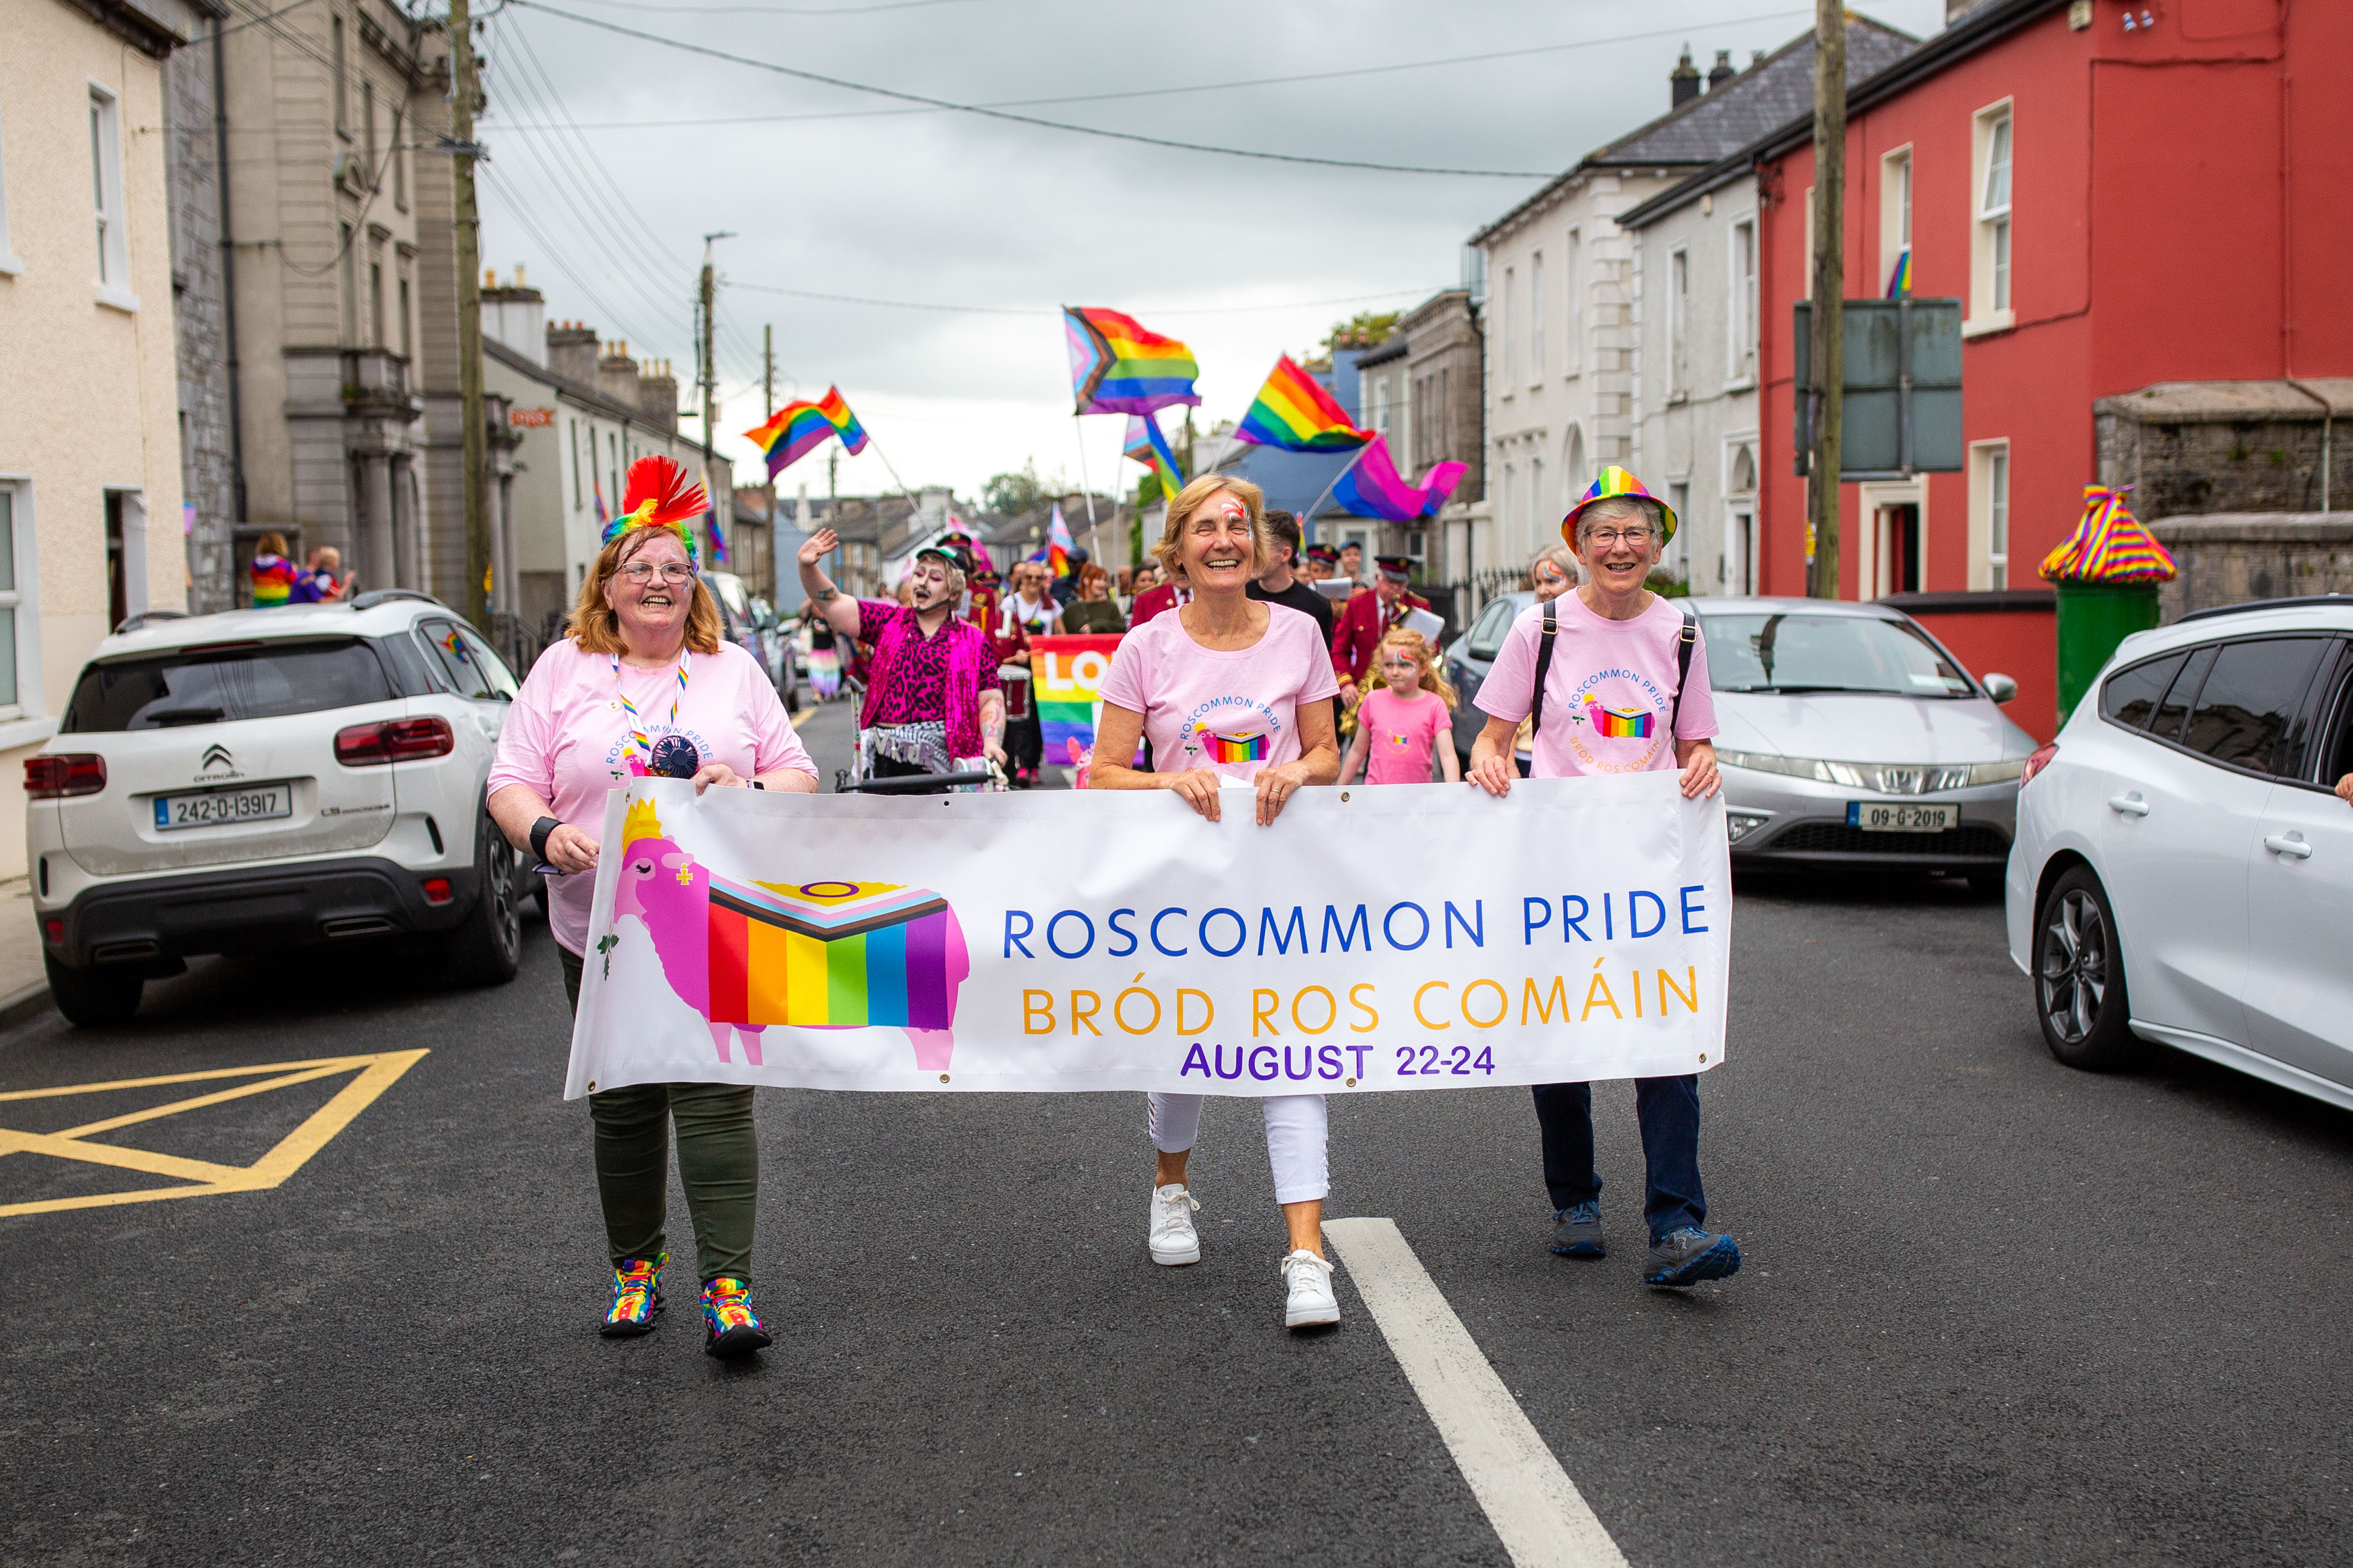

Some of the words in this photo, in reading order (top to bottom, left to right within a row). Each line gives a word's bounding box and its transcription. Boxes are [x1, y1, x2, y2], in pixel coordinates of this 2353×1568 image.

[1044, 650, 1116, 690] LO
[1568, 669, 1639, 709] ROSCOMMON
[1642, 681, 1666, 713] PRIDE
[1180, 696, 1253, 740] ROSCOMMON
[1257, 703, 1281, 732] PRIDE
[686, 730, 713, 759] PRIDE
[1570, 737, 1593, 764] BRÓD
[1597, 762, 1619, 773] ROS
[1624, 740, 1660, 772] COMÁIN
[177, 793, 277, 822] 242-D-13917
[1872, 809, 1946, 827] 09-G-2019
[1004, 899, 1485, 959] ROSCOMMON
[1523, 885, 1709, 946] PRIDE
[1022, 971, 1215, 1036] BRÓD
[1252, 982, 1379, 1037] ROS
[1413, 956, 1698, 1030] COMÁIN
[1180, 1042, 1374, 1082] AUGUST
[1396, 1045, 1496, 1076] 22-24
